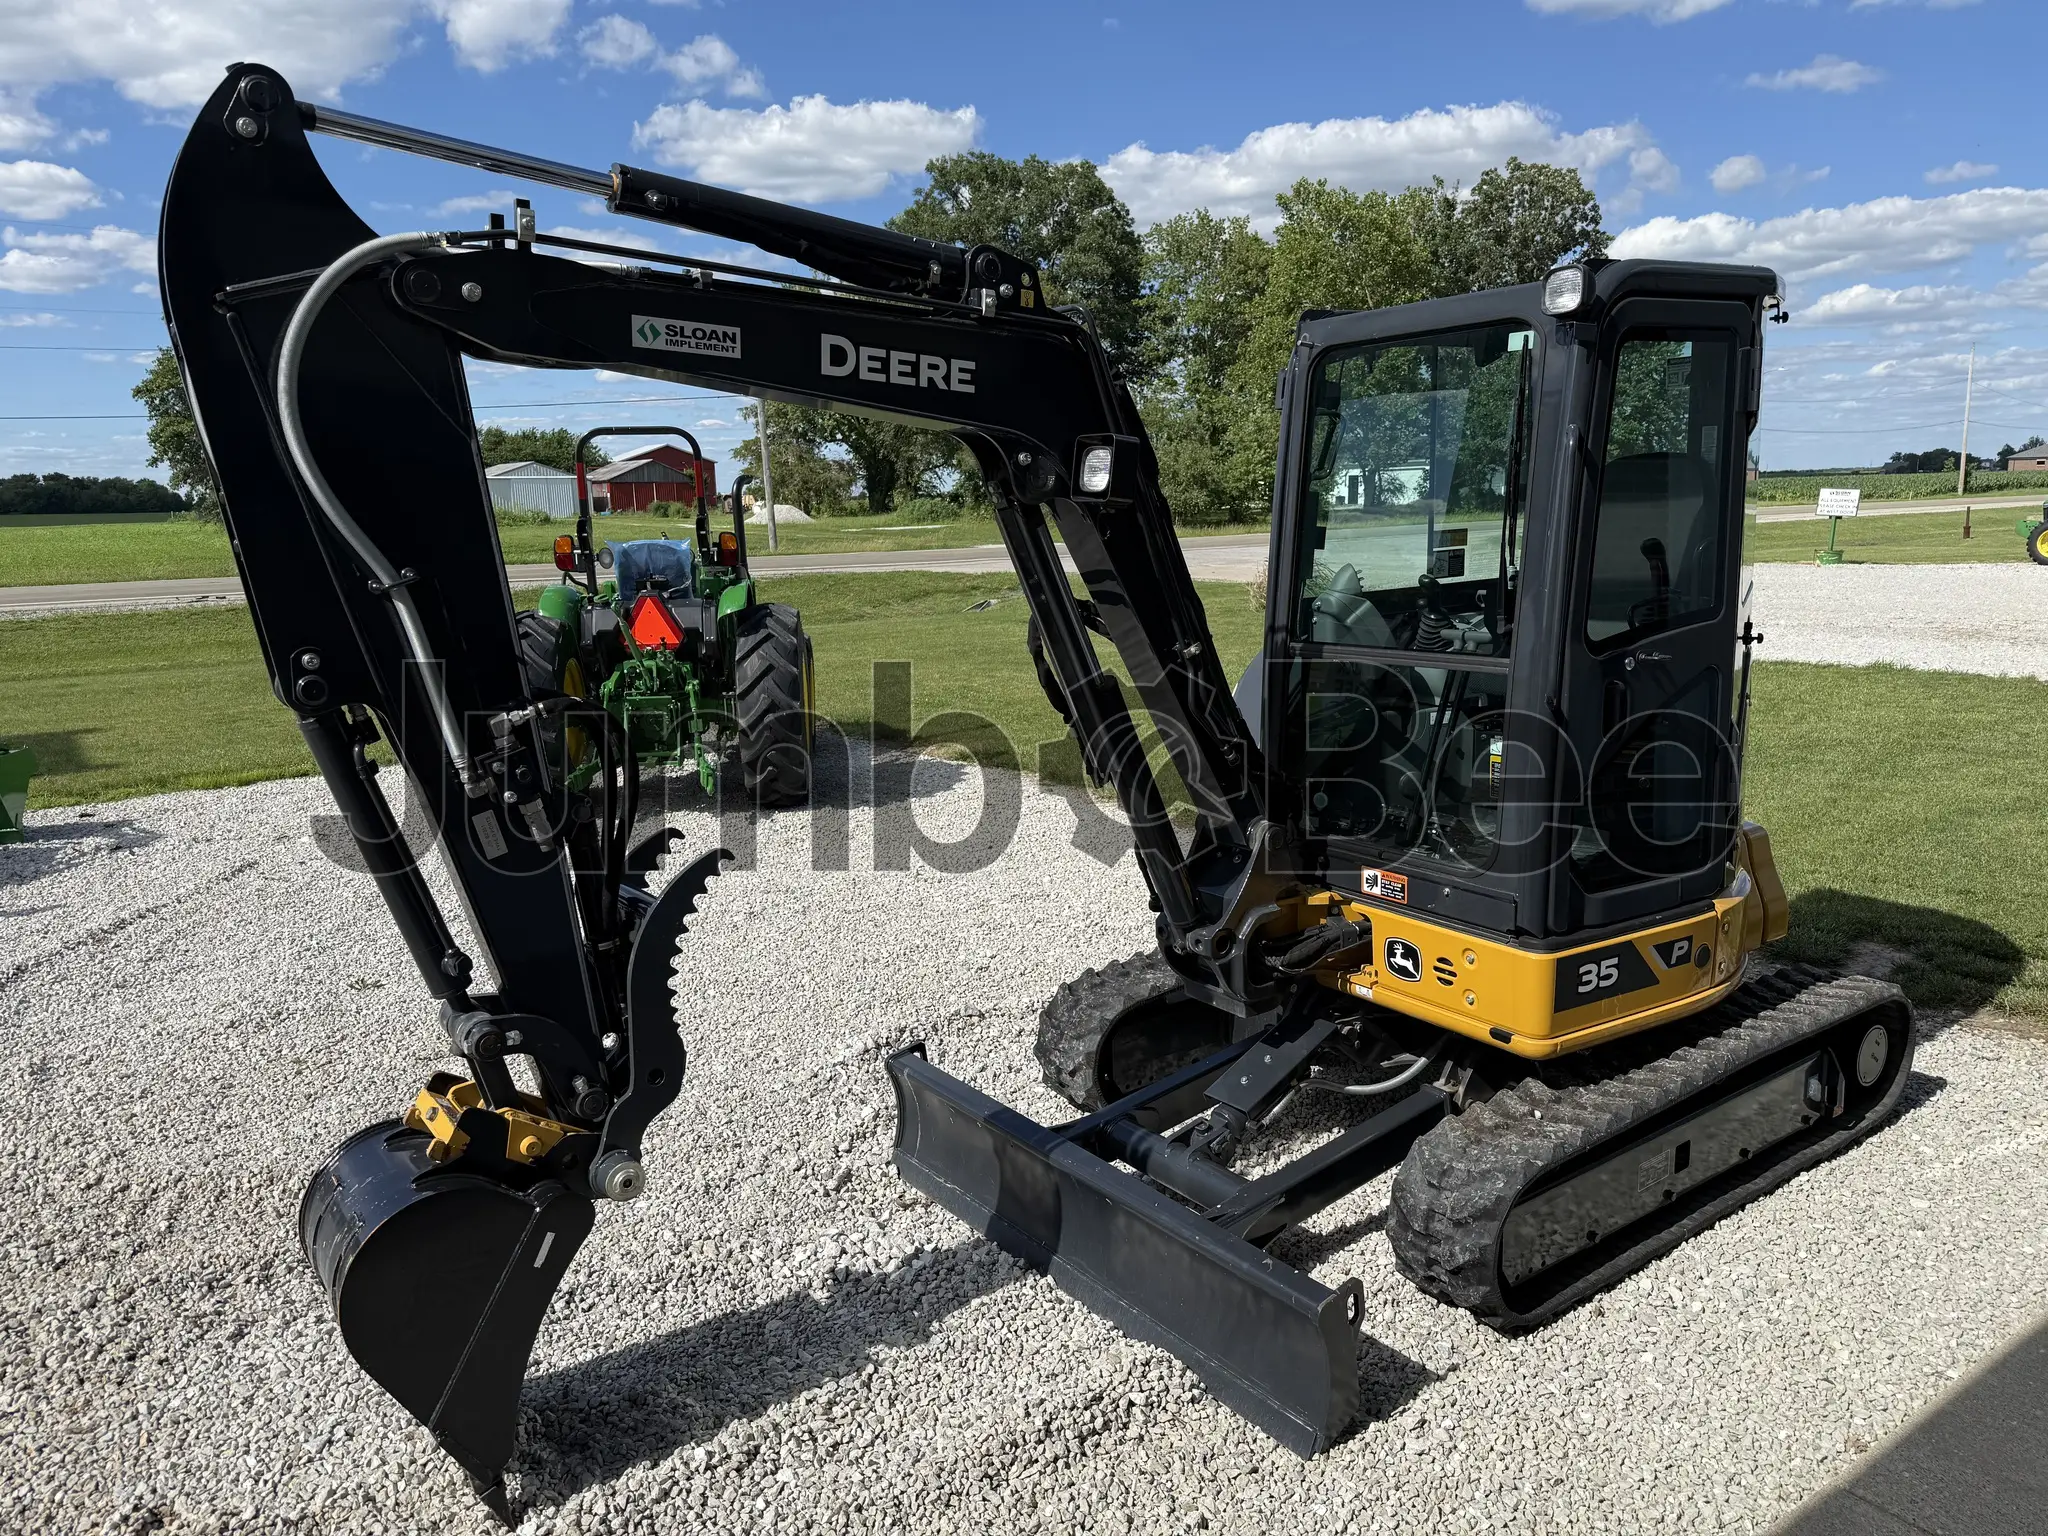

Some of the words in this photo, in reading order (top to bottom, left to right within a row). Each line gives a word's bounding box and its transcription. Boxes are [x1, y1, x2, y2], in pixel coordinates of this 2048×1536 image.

[664, 324, 737, 345] SLOAN
[664, 338, 738, 354] IMPLEMENT
[820, 333, 976, 394] DEERE
[1577, 956, 1619, 993] 35
[1670, 940, 1690, 965] P
